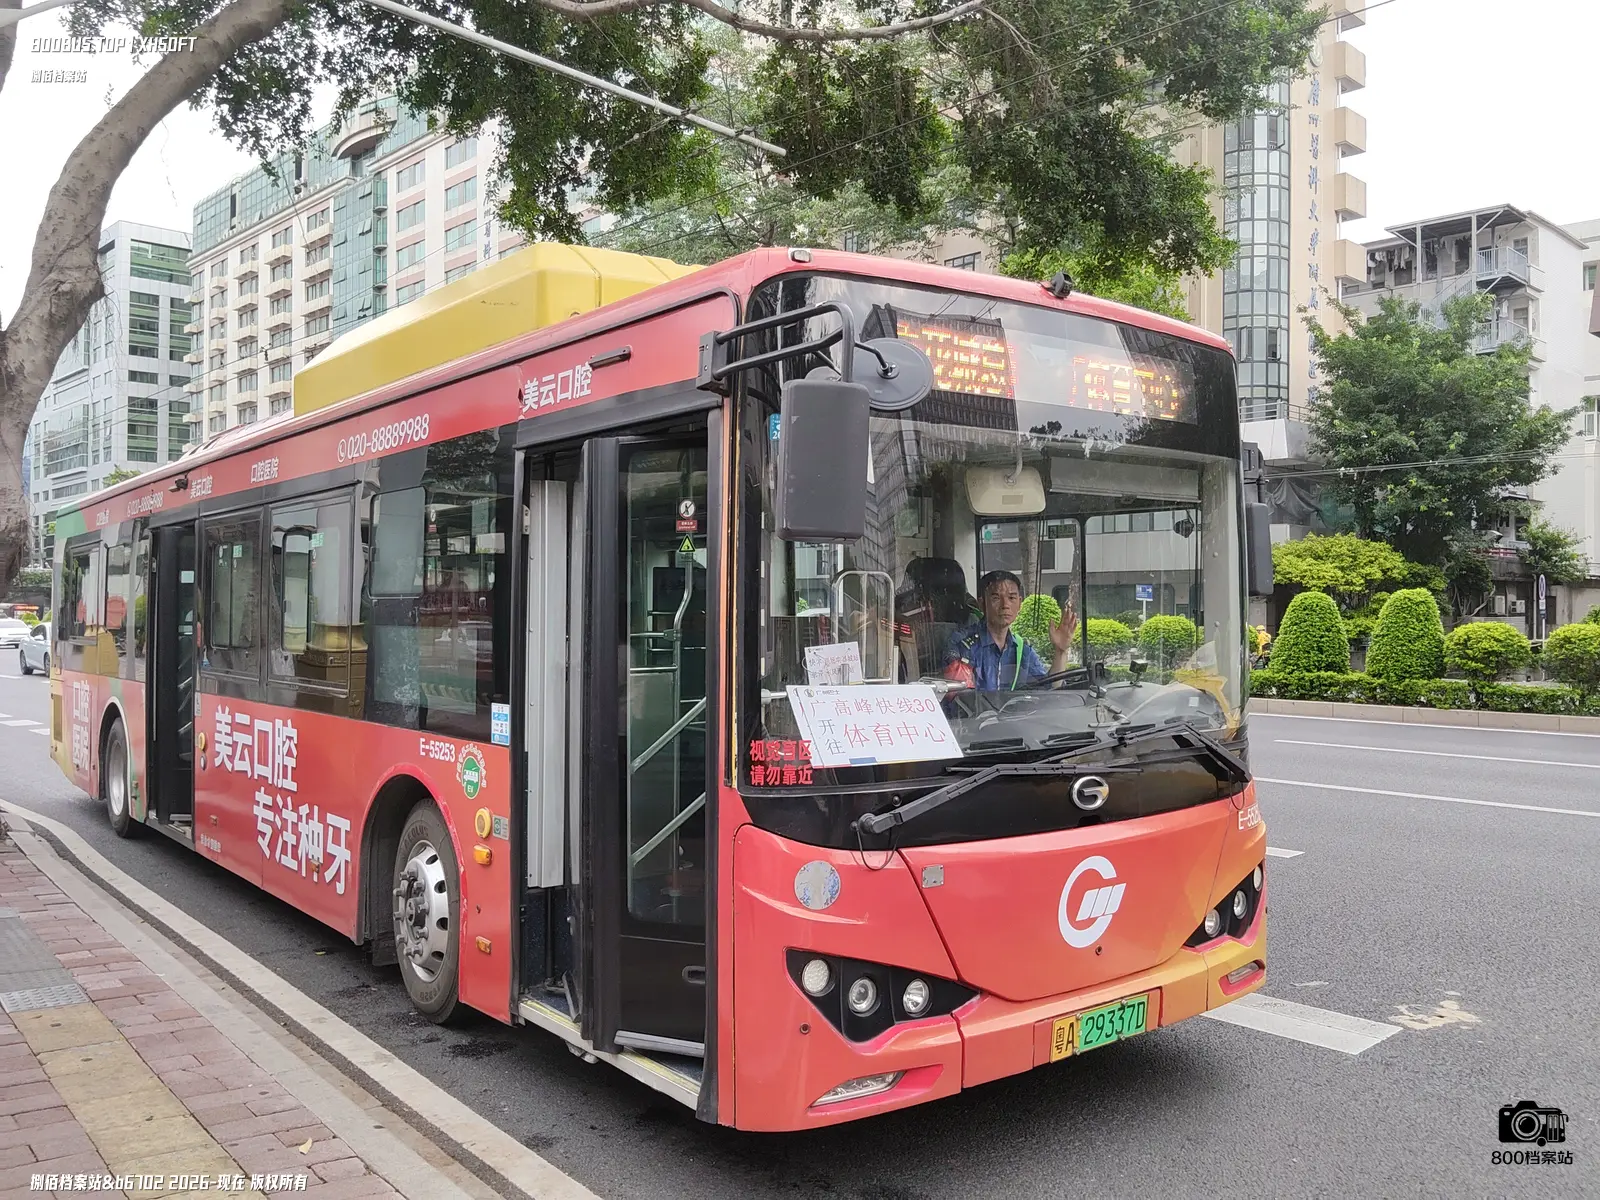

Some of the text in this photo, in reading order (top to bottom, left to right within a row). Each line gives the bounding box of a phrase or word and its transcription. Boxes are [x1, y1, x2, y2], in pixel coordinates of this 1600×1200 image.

[522, 364, 592, 413] 美云口腔
[347, 413, 430, 460] 020-88889988
[190, 475, 213, 499] 美云口腔
[250, 456, 279, 483] 口腔医院
[214, 704, 298, 792] 美云口腔
[419, 738, 456, 763] E-55253
[843, 721, 946, 749] 体育中心
[750, 764, 813, 786] 请勿靠近
[253, 786, 351, 895] 专注种牙
[1082, 999, 1147, 1046] 29337D
